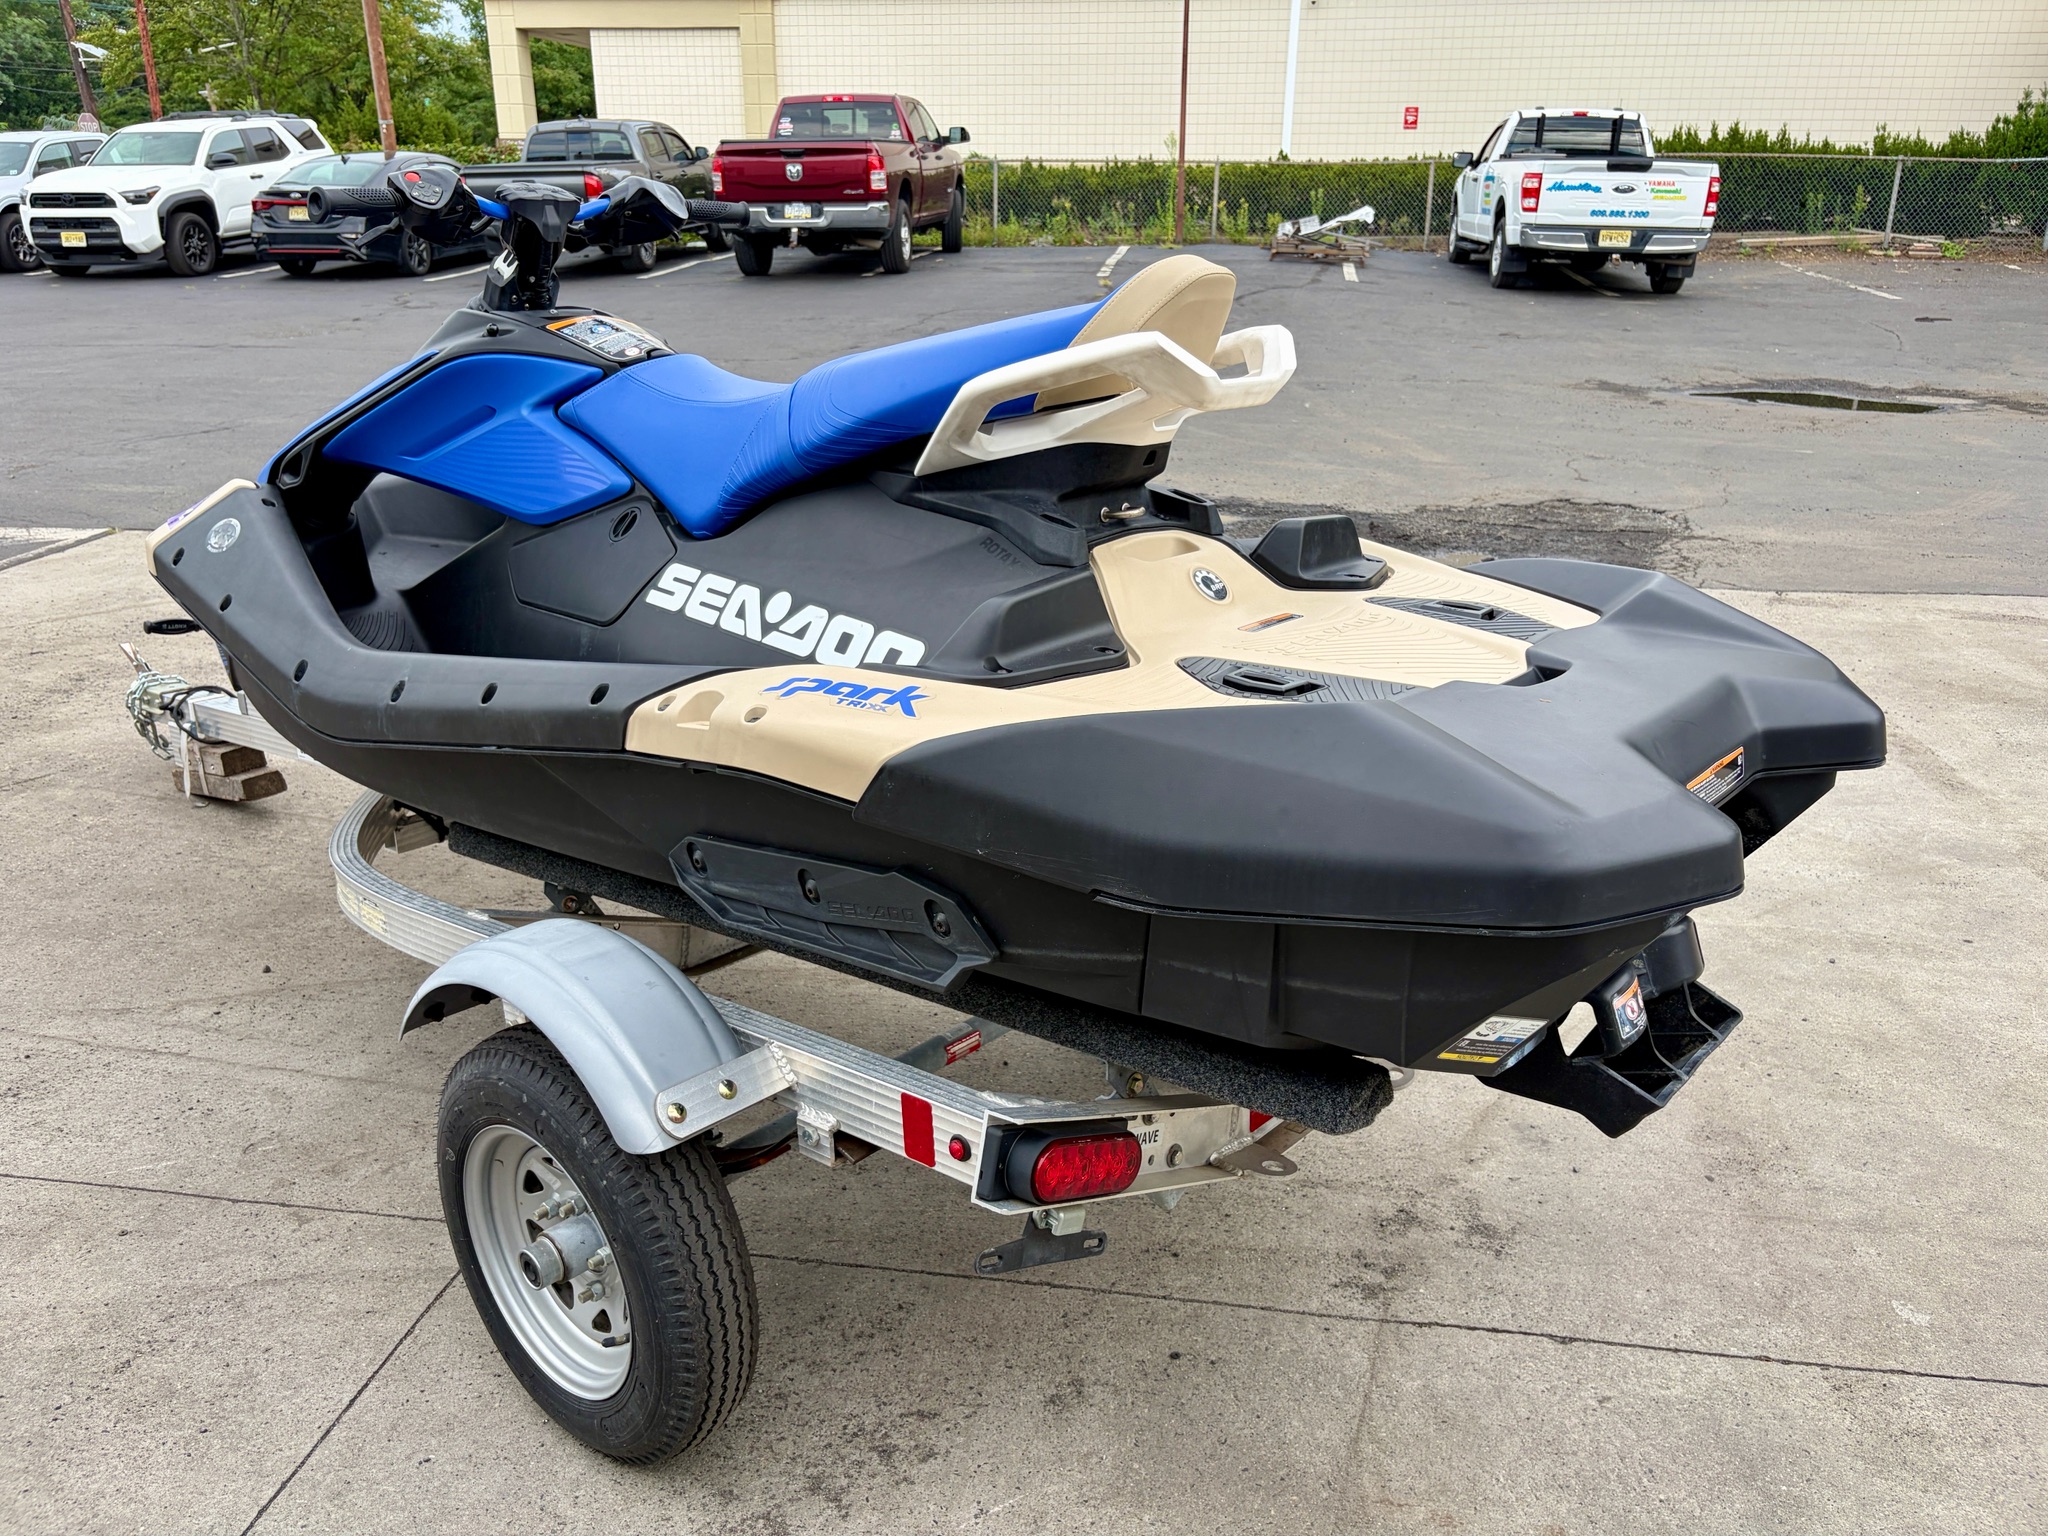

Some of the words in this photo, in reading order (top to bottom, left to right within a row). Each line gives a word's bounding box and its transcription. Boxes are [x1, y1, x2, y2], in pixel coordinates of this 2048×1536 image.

[80, 122, 97, 132] STOP
[1210, 582, 1223, 591] BRP
[836, 697, 891, 713] TRIXX
